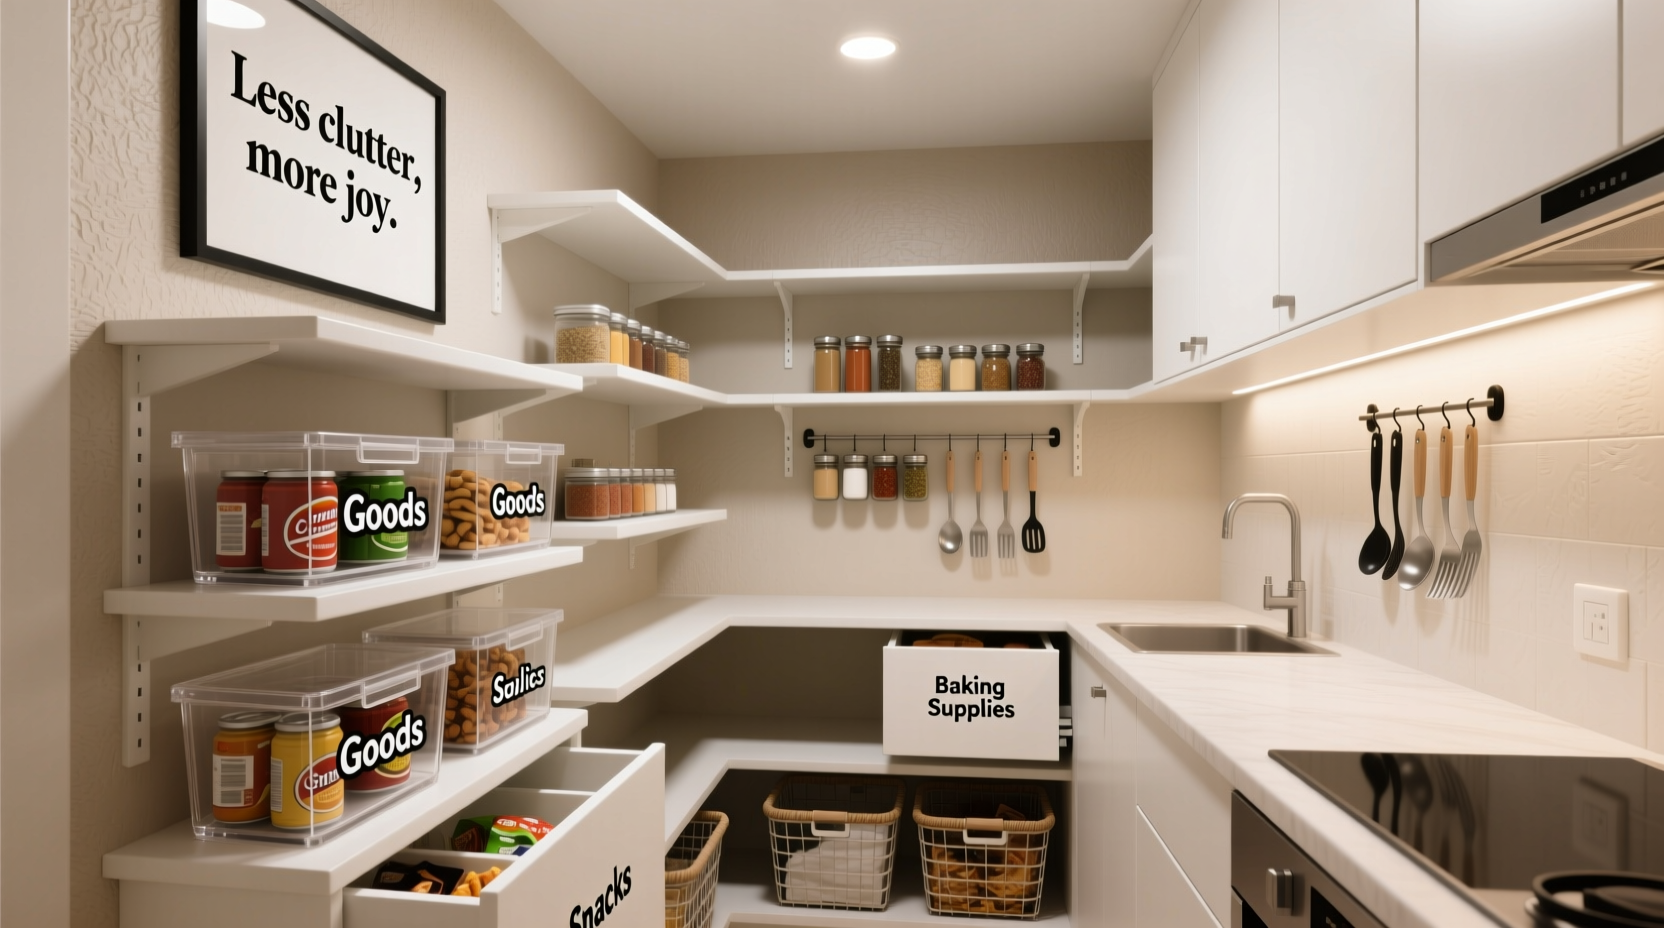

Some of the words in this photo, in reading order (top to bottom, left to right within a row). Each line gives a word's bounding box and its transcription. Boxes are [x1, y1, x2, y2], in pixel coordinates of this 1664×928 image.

[230, 50, 310, 131] Less
[318, 104, 422, 194] clutter,
[246, 140, 337, 204] more
[341, 169, 397, 234] joy.
[343, 490, 427, 534] Goods
[492, 484, 545, 516] Goods
[927, 697, 1015, 723] Supplies
[935, 674, 1005, 701] Baking
[339, 713, 424, 776] Goods
[569, 864, 632, 928] Snacks
